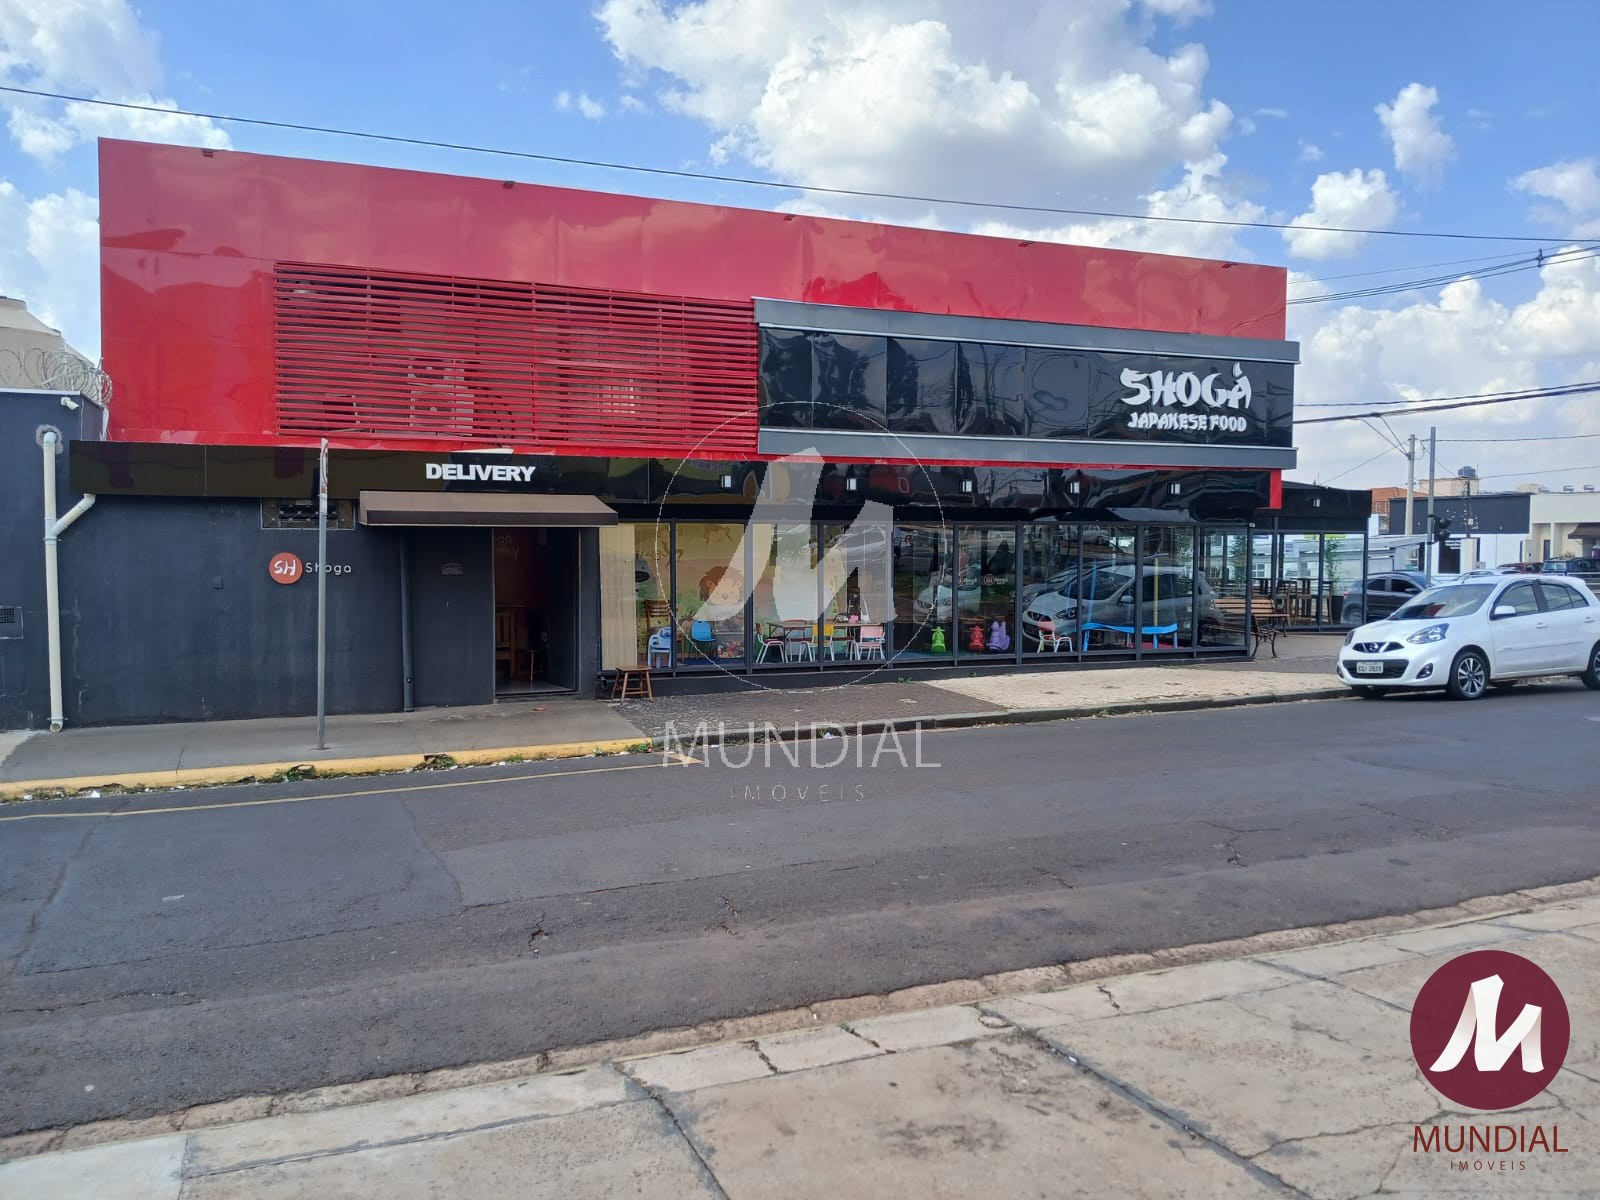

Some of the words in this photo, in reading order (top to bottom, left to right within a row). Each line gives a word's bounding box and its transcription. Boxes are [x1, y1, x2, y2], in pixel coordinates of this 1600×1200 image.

[1127, 412, 1208, 431] JAPANESE
[1209, 415, 1247, 432] FOOD
[425, 463, 536, 482] DELIVERY
[274, 559, 297, 576] SH
